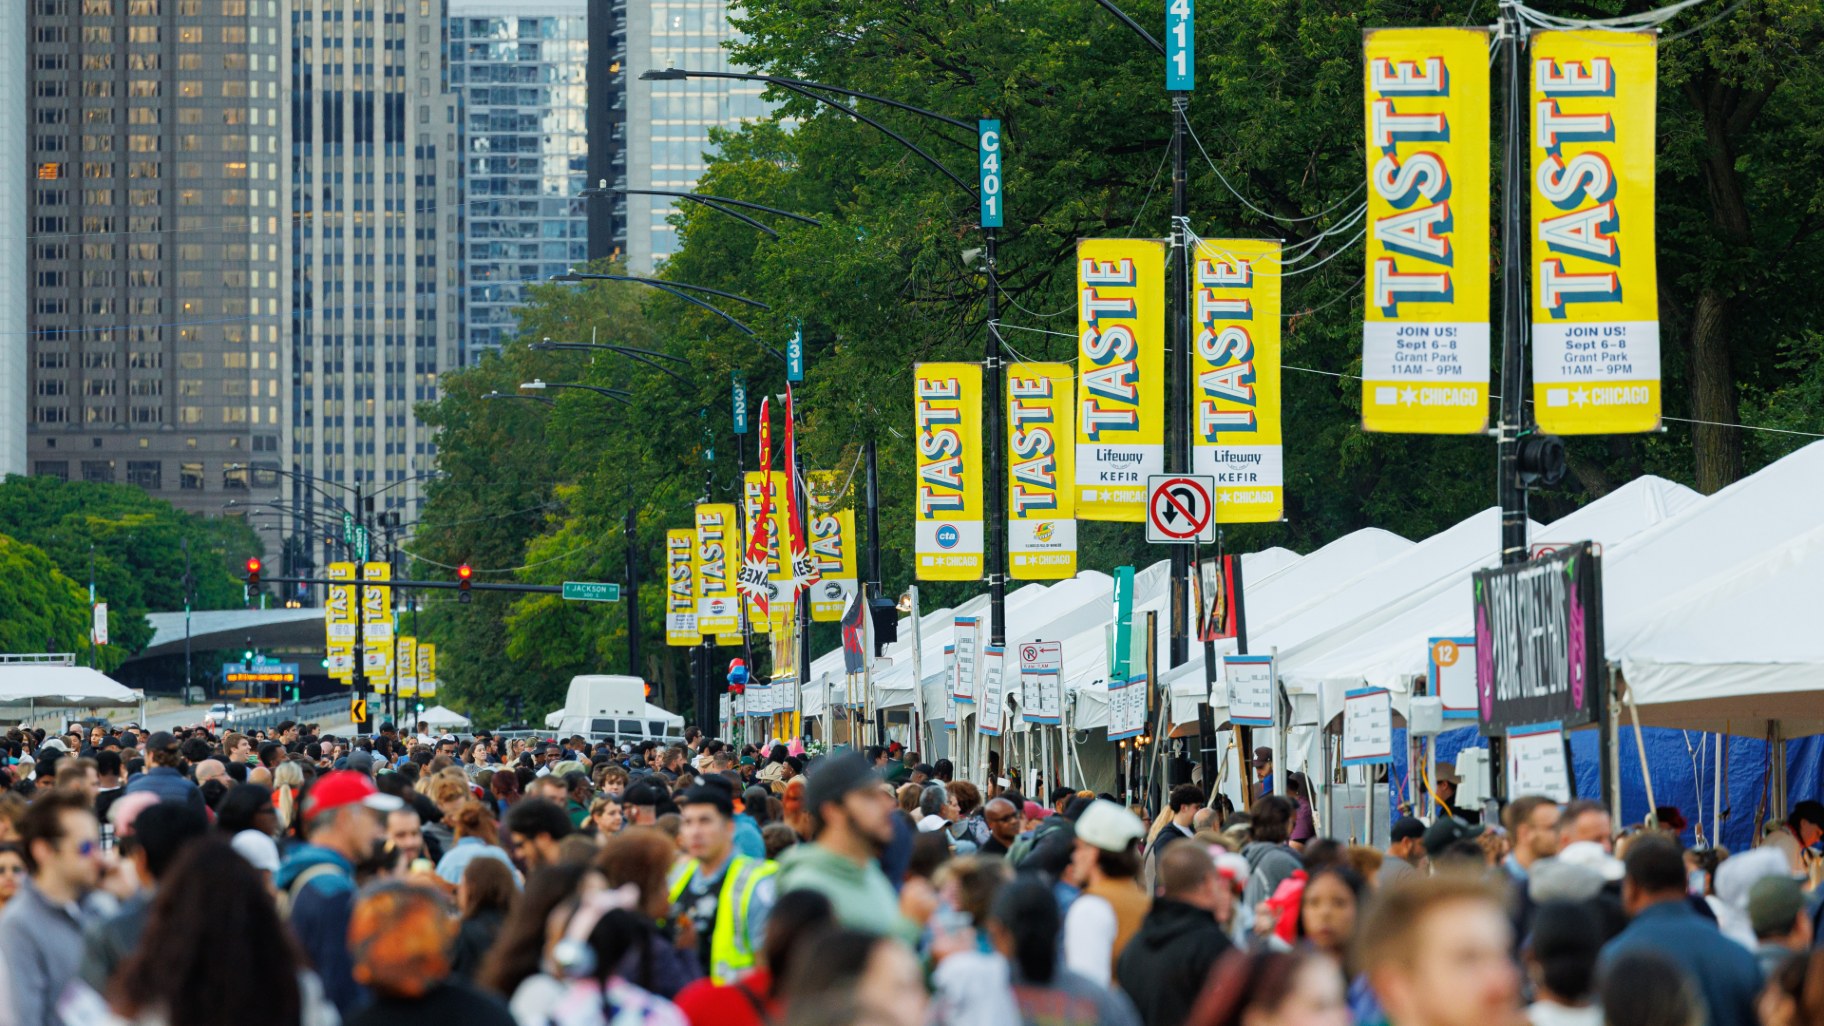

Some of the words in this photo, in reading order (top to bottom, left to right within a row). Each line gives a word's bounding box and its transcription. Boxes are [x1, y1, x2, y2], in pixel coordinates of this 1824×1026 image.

[981, 131, 999, 216] C401
[1370, 56, 1454, 318] TASTE
[1536, 56, 1623, 319] TASTE
[1396, 326, 1429, 338] JOIN
[1432, 326, 1458, 337] US!
[1565, 326, 1599, 338] JOIN
[1602, 326, 1627, 337] US!
[1082, 257, 1140, 442] TASTE
[1197, 258, 1258, 443] TASTE
[1396, 339, 1427, 351] Sept
[1565, 339, 1597, 351] Sept
[1394, 351, 1429, 363] Grant
[1431, 351, 1458, 363] Park
[1564, 351, 1598, 363] Grant
[1601, 351, 1628, 363] Park
[1391, 364, 1424, 376] 11AM
[1436, 364, 1462, 376] 9PM
[1561, 364, 1594, 376] 11AM
[1606, 364, 1632, 375] 9PM
[1420, 387, 1478, 407] CHICAGO
[1591, 386, 1650, 406] CHICAGO
[918, 377, 965, 519] TASTE
[1010, 376, 1058, 518] TASTE
[1096, 448, 1143, 464] Lifeway
[1214, 450, 1261, 465] Lifeway
[1100, 472, 1138, 482] KEFIR
[1218, 473, 1257, 482] KEFIR
[1113, 490, 1147, 504] CHICAG
[1233, 491, 1274, 504] CHICAGO
[939, 532, 956, 540] cta
[697, 512, 726, 597] TASTE
[946, 556, 978, 567] CHICAGO
[1038, 554, 1070, 566] CHICAGO
[668, 535, 692, 612] TASTE
[1437, 645, 1453, 663] 12
